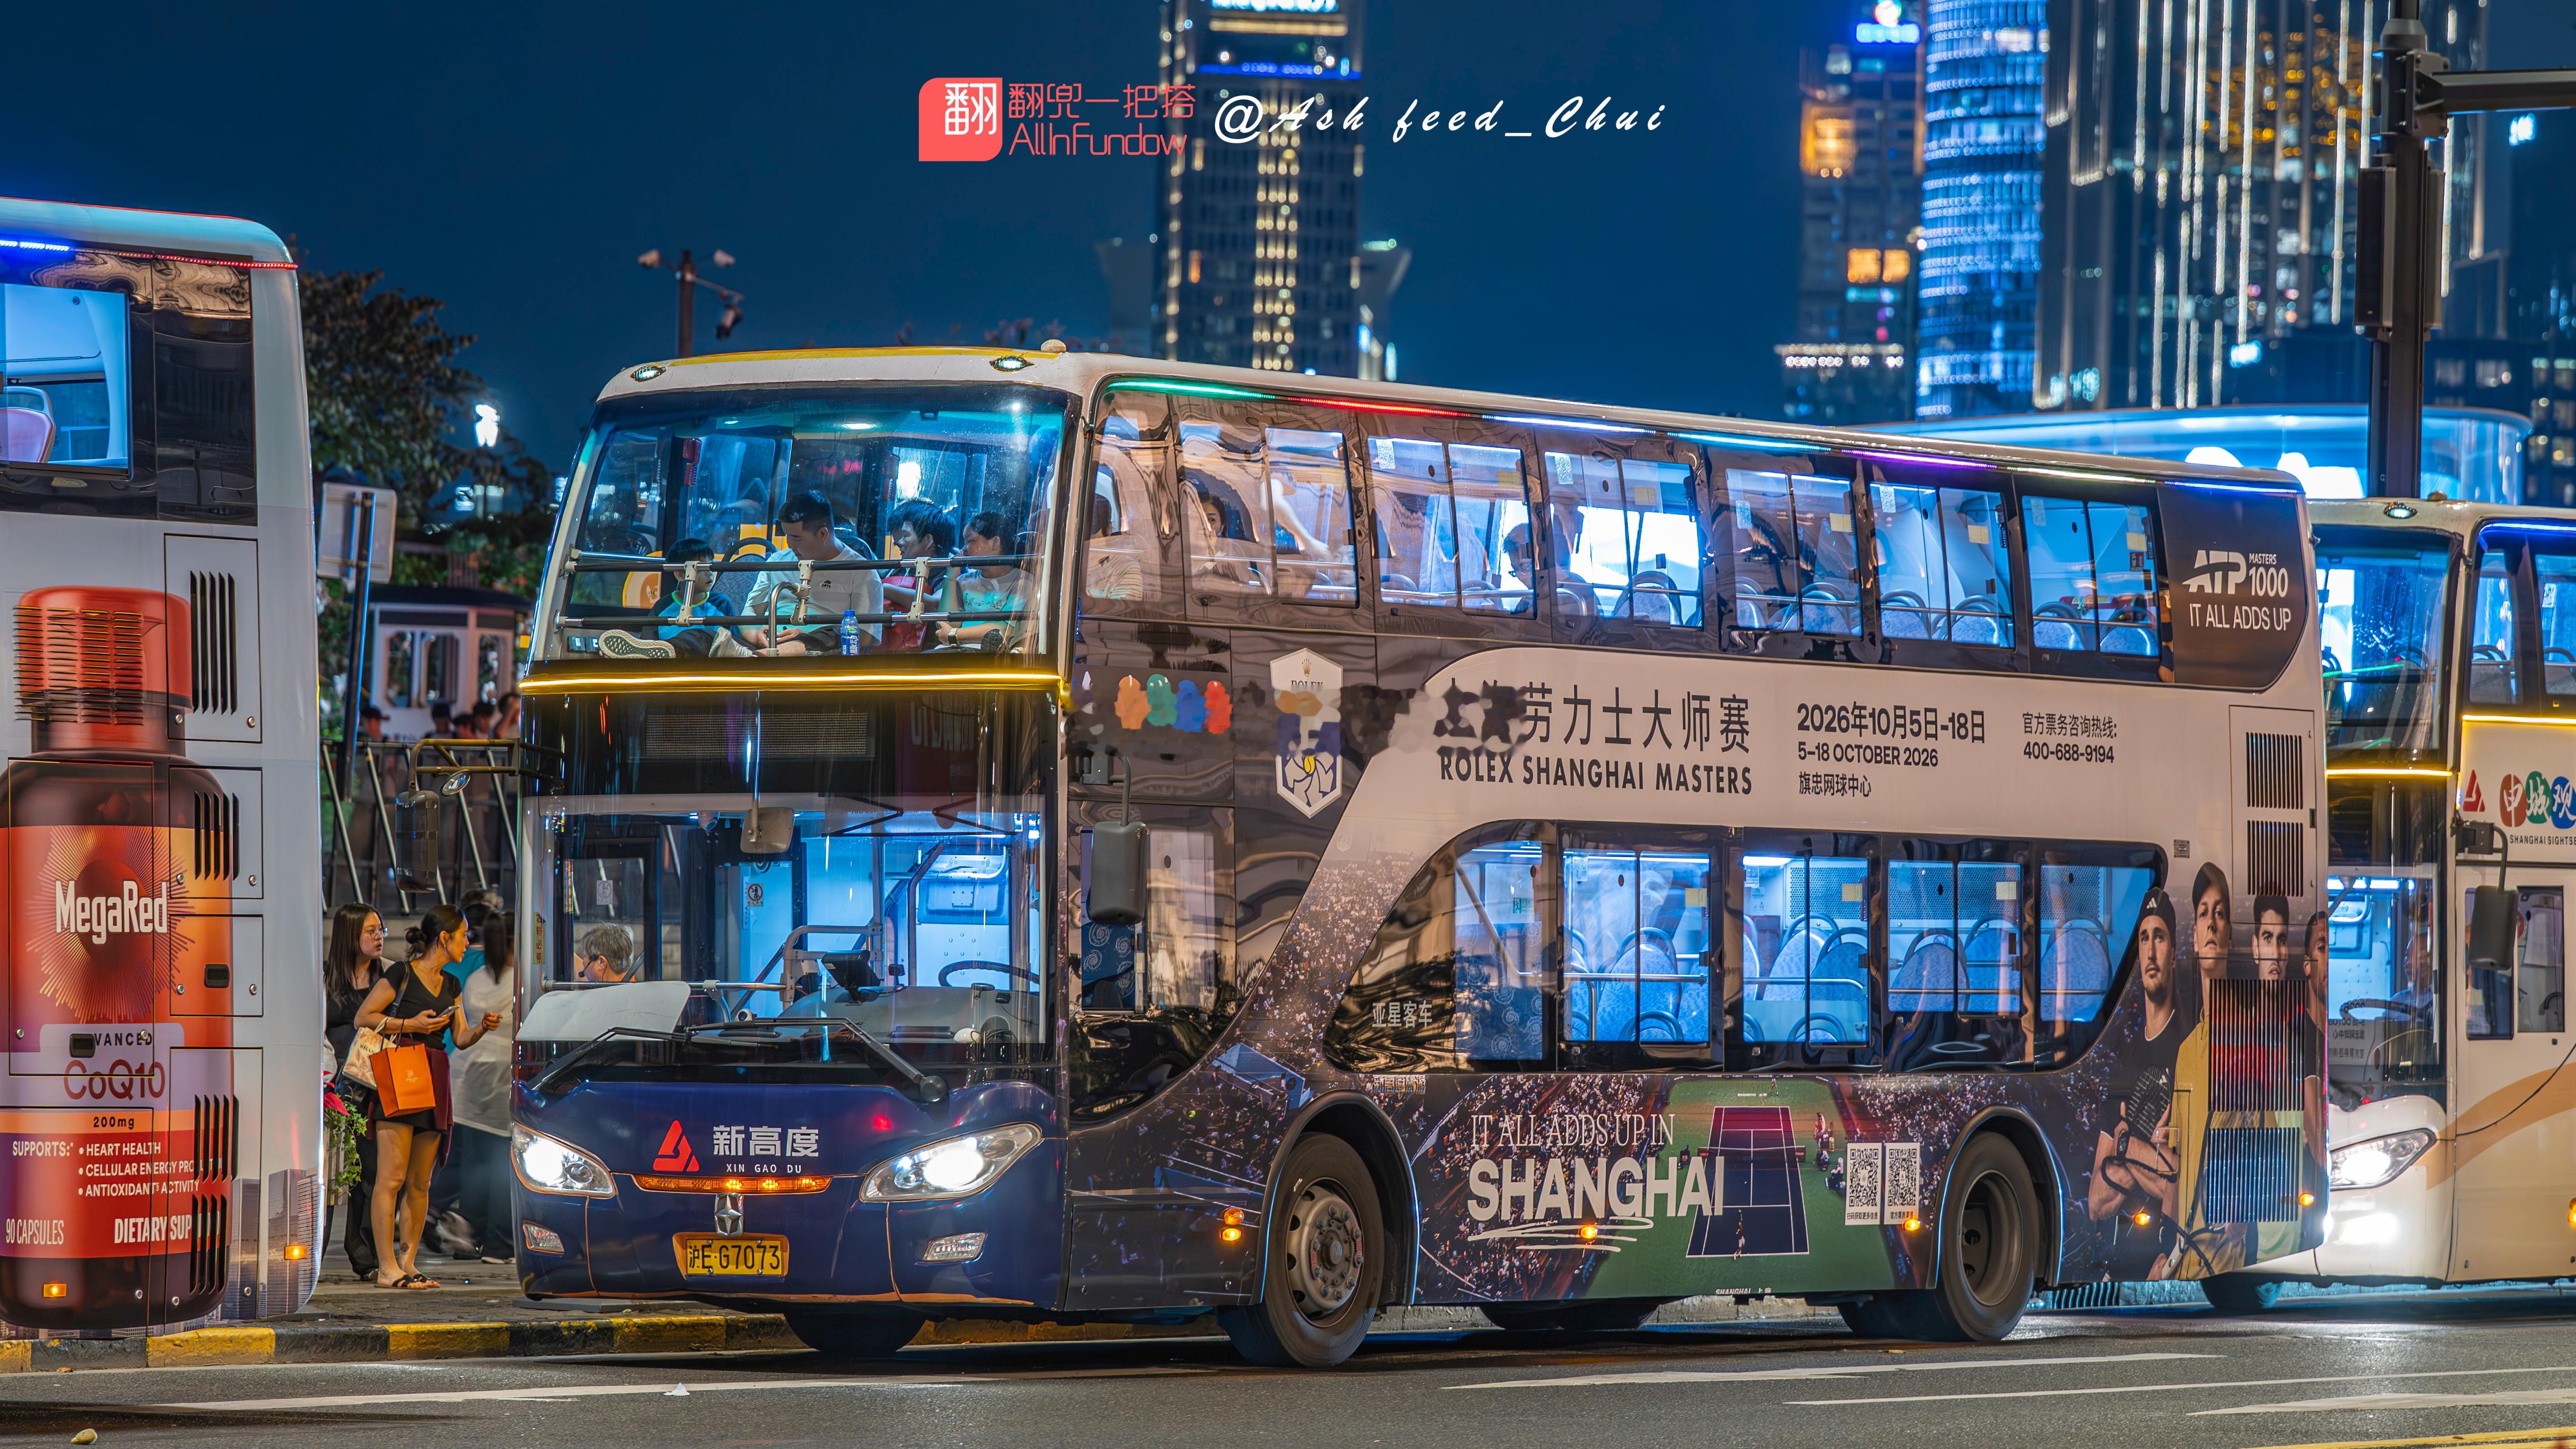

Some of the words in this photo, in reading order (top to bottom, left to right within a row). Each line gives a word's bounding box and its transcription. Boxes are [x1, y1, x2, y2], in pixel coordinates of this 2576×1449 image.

[2182, 550, 2246, 594] ATP
[2249, 553, 2277, 565] MASTERS
[2249, 567, 2288, 597] 1000
[2189, 603, 2201, 627] IT
[2205, 604, 2230, 628] ALL
[2233, 606, 2270, 630] ADDS
[2273, 607, 2291, 631] UP
[1434, 677, 1750, 754] 劳力士大师赛
[1797, 701, 1985, 744] 2026年10月5日-18日
[2022, 711, 2117, 739] 官方票务咨询热线:
[1833, 743, 1901, 767] OCTOBER
[1903, 747, 1939, 767] 2026
[2023, 742, 2115, 763] 400-688-9194
[1441, 752, 1513, 783] ROLEX
[1523, 755, 1644, 790] SHANGHAI
[1655, 762, 1752, 795] MASTERS
[1799, 770, 1872, 798] 旗忠网球中心
[2510, 835, 2546, 845] SHANGHAI
[55, 880, 168, 944] MegaRed
[1372, 1000, 1433, 1028] 亚星客车
[95, 1033, 153, 1046] VANCED
[64, 1059, 165, 1101] CoQ10
[93, 1116, 135, 1130] 200mg
[1471, 1114, 1493, 1147] IT
[1498, 1114, 1542, 1147] ALL
[1545, 1114, 1609, 1146] ADDS
[1614, 1113, 1646, 1146] UP
[1649, 1113, 1674, 1145] IN
[86, 1143, 120, 1157] HEART
[122, 1142, 161, 1155] HEALTH
[713, 1125, 819, 1157] 新高度
[85, 1163, 138, 1177] CELLULAR
[140, 1162, 177, 1175] ENERGY
[726, 1163, 745, 1173] XIN
[754, 1164, 777, 1173] GAO
[787, 1164, 802, 1173] DU
[161, 1179, 200, 1194] ACTIVITY
[1468, 1156, 1724, 1221] SHANGHAI
[5, 1218, 15, 1244] 90
[16, 1219, 65, 1245] CAPSULES
[114, 1216, 167, 1244] DIETARY
